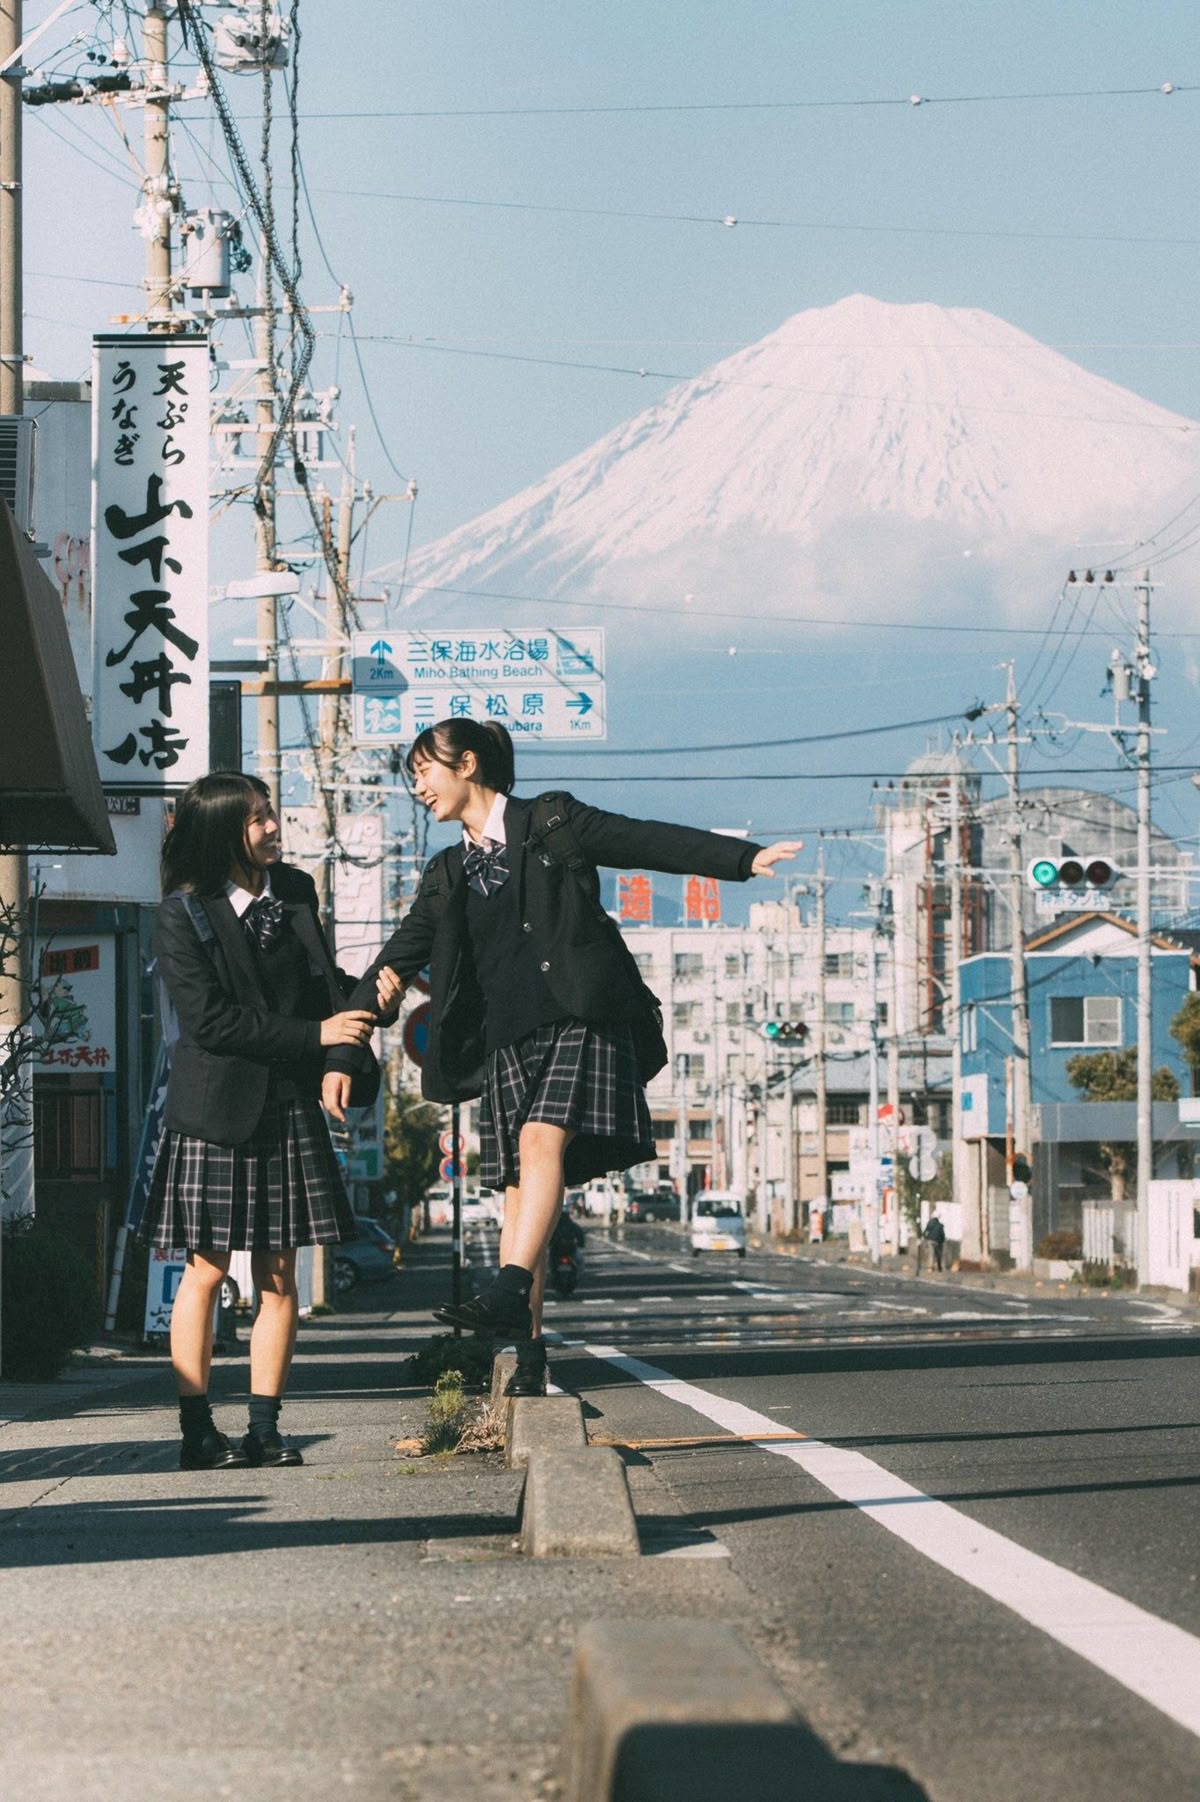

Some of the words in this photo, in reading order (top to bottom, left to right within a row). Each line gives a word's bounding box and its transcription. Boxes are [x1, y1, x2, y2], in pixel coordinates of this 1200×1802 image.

[112, 361, 140, 466] うなぎ
[153, 360, 190, 467] 天ぷら
[103, 472, 200, 770] 山下天丼店
[407, 638, 549, 663] 三保海水浴場
[369, 668, 394, 680] 2Km
[414, 667, 446, 679] Miho
[450, 665, 498, 680] Bathing
[503, 665, 543, 677] Beach
[413, 692, 545, 717] 三保松原
